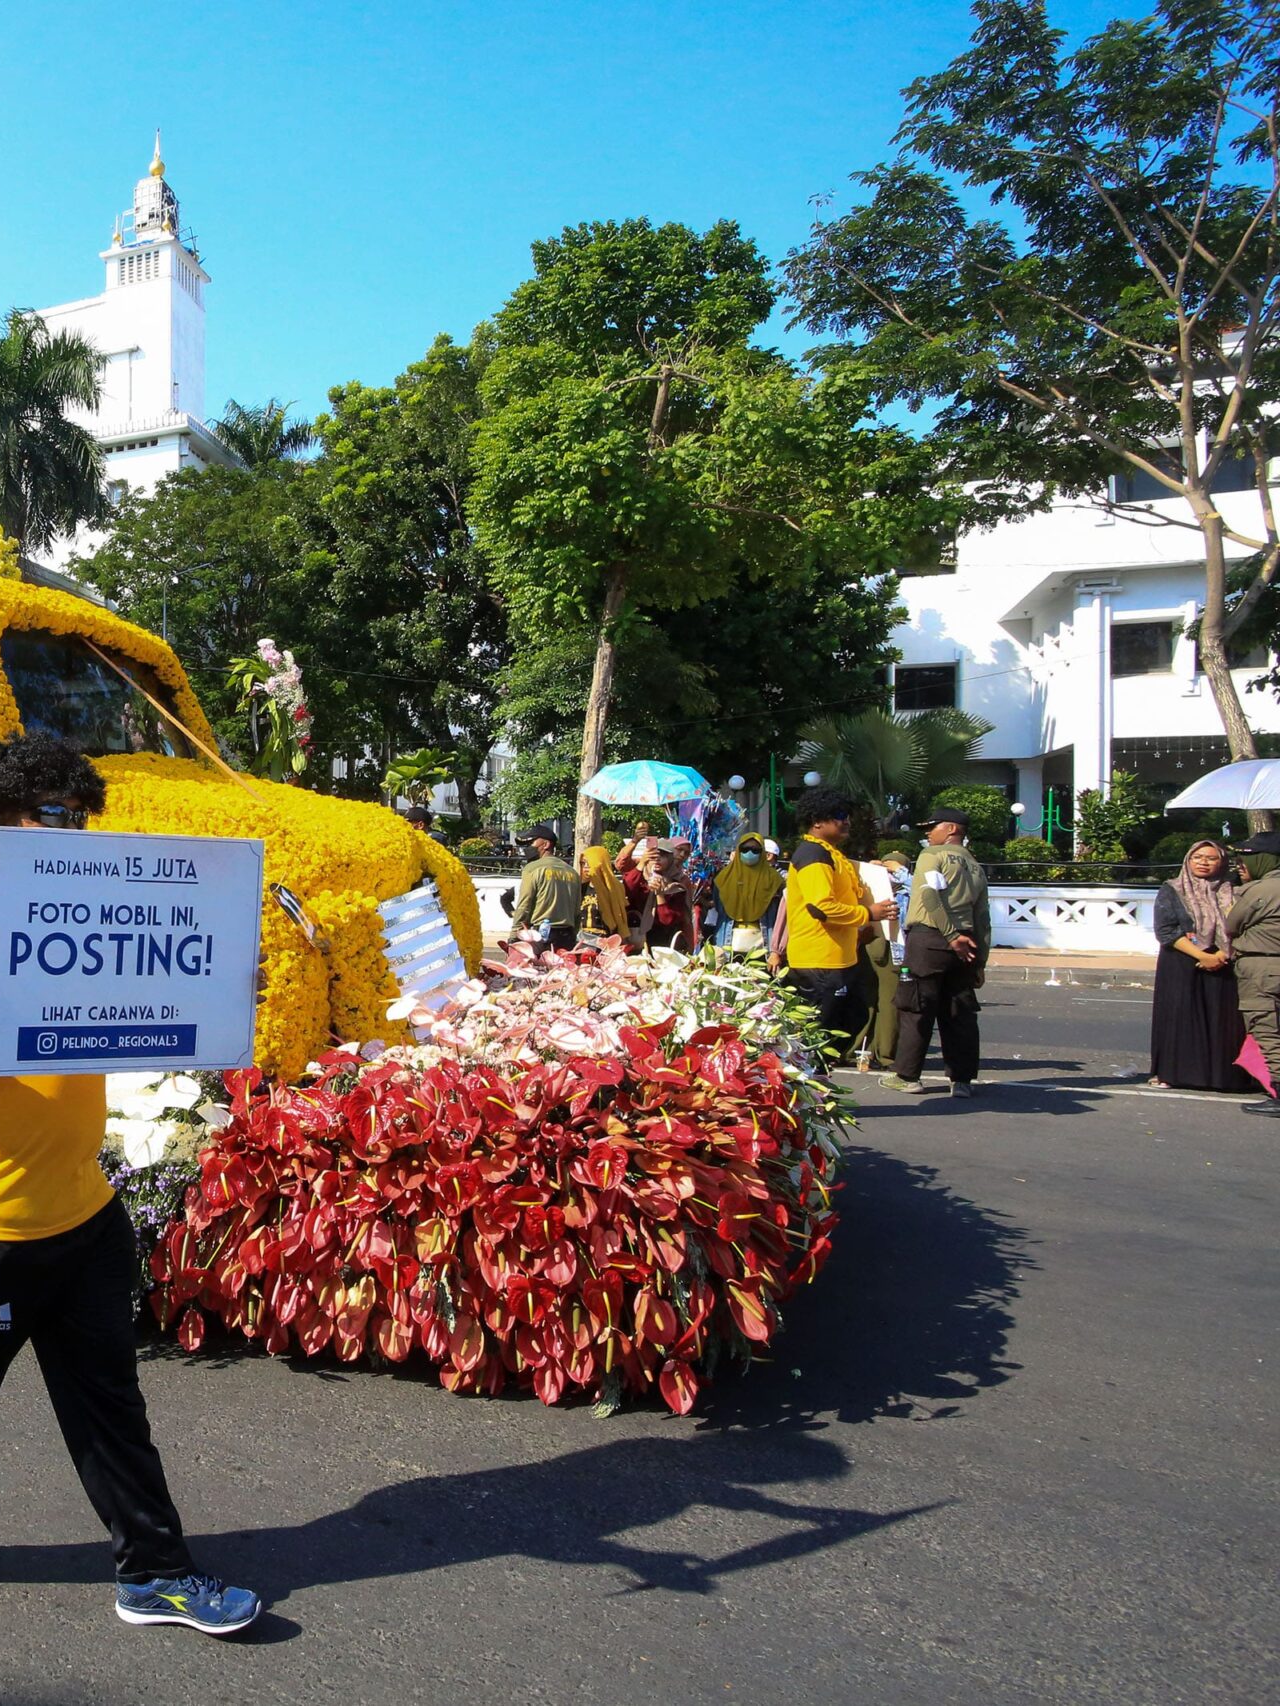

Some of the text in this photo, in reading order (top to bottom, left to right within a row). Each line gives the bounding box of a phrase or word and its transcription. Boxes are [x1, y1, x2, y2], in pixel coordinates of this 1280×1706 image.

[34, 856, 197, 879] HADIAHNYA 15 JUTA
[28, 902, 199, 930] FOTO MOBIL INI,
[9, 932, 213, 977] POSTING!
[42, 1006, 179, 1022] LIHAT CARANYA DI:
[62, 1035, 178, 1050] PELINDO_REGIONAL3
